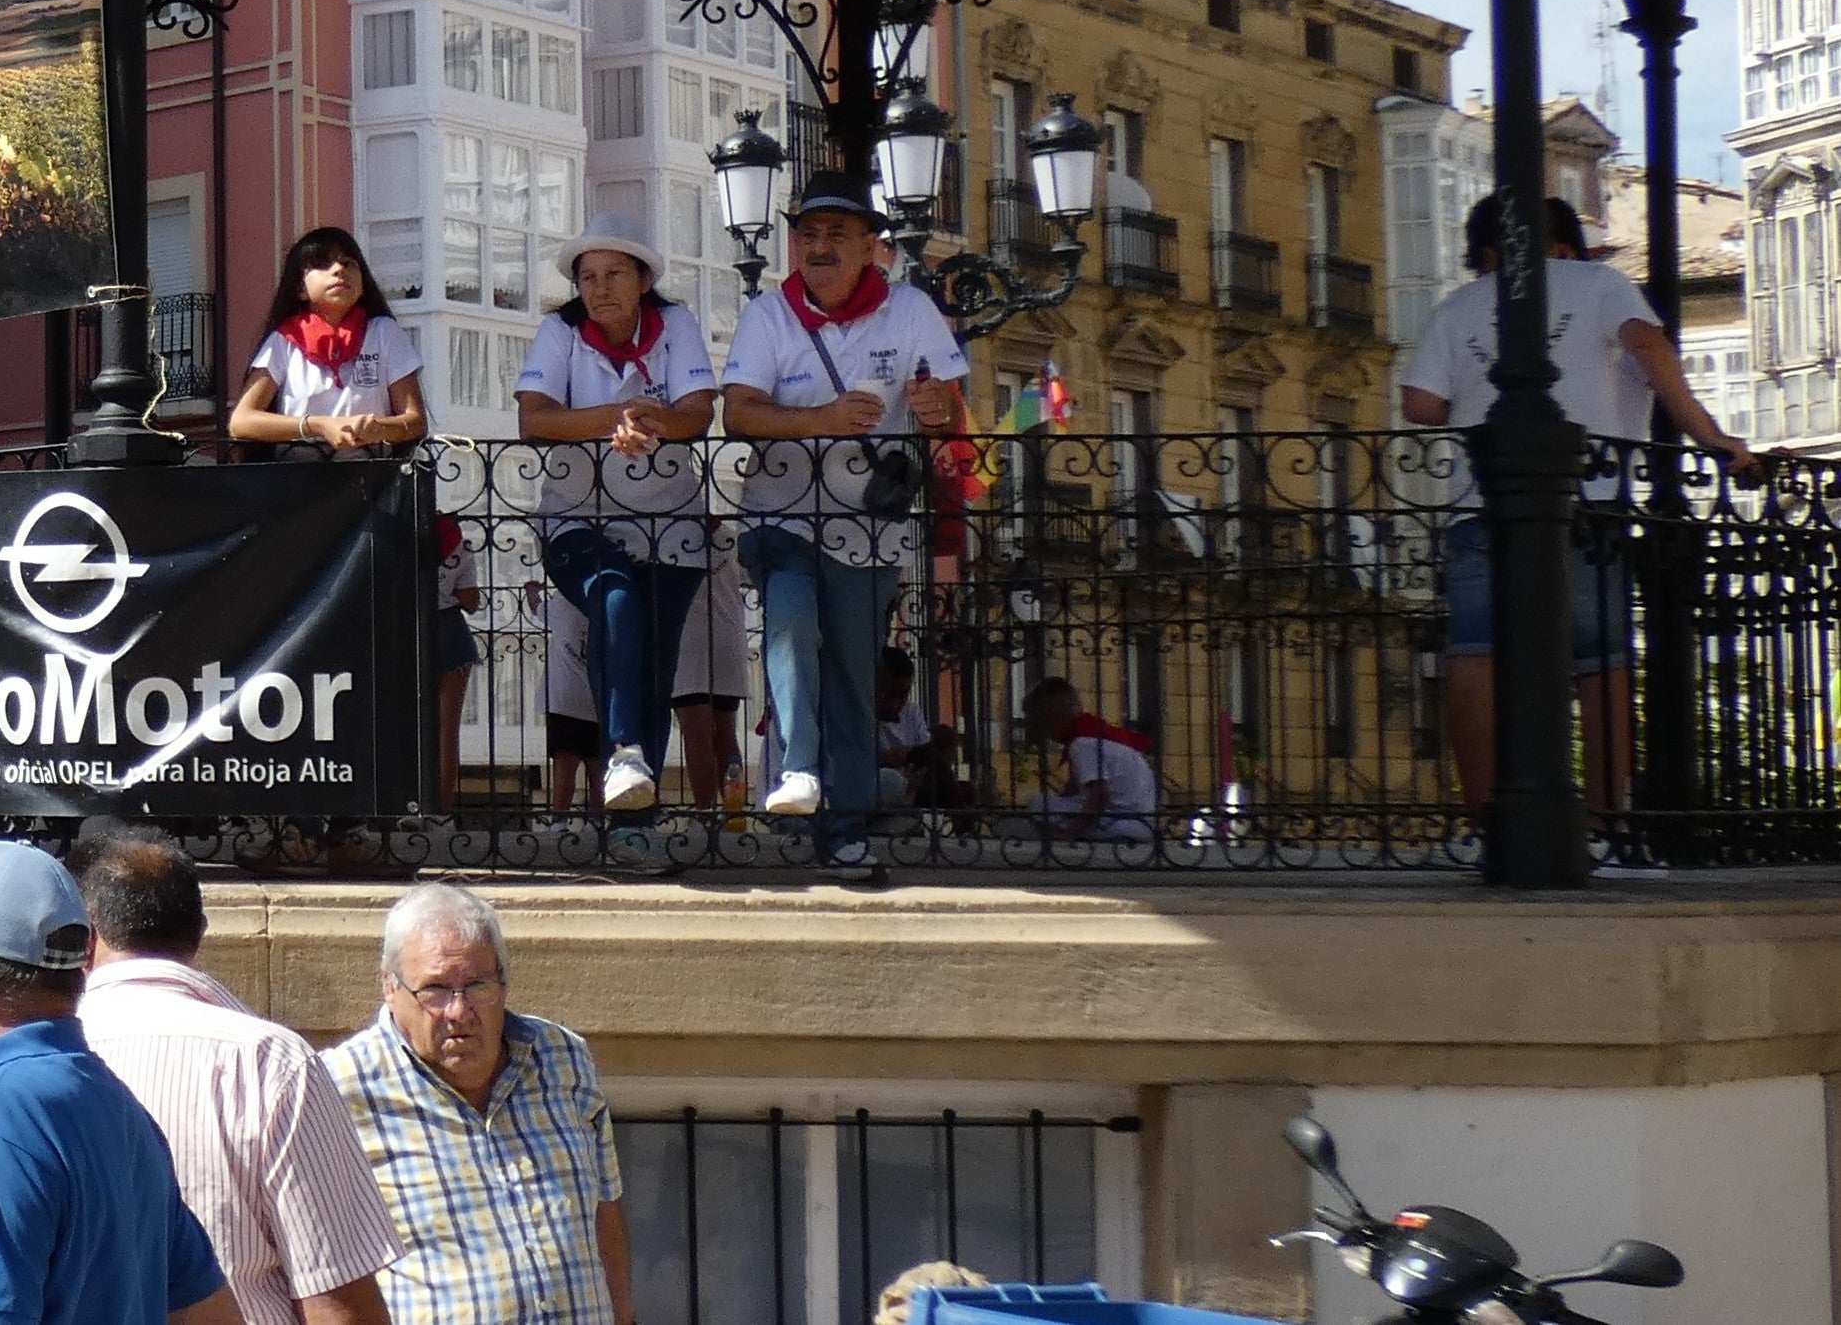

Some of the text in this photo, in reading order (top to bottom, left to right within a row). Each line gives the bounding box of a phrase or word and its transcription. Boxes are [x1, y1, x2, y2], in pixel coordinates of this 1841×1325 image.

[5, 758, 58, 785] oficial
[58, 761, 119, 786] OPEL
[126, 760, 185, 789] para
[192, 756, 215, 782] la
[224, 757, 291, 789] Rioja
[298, 757, 353, 783] Alta
